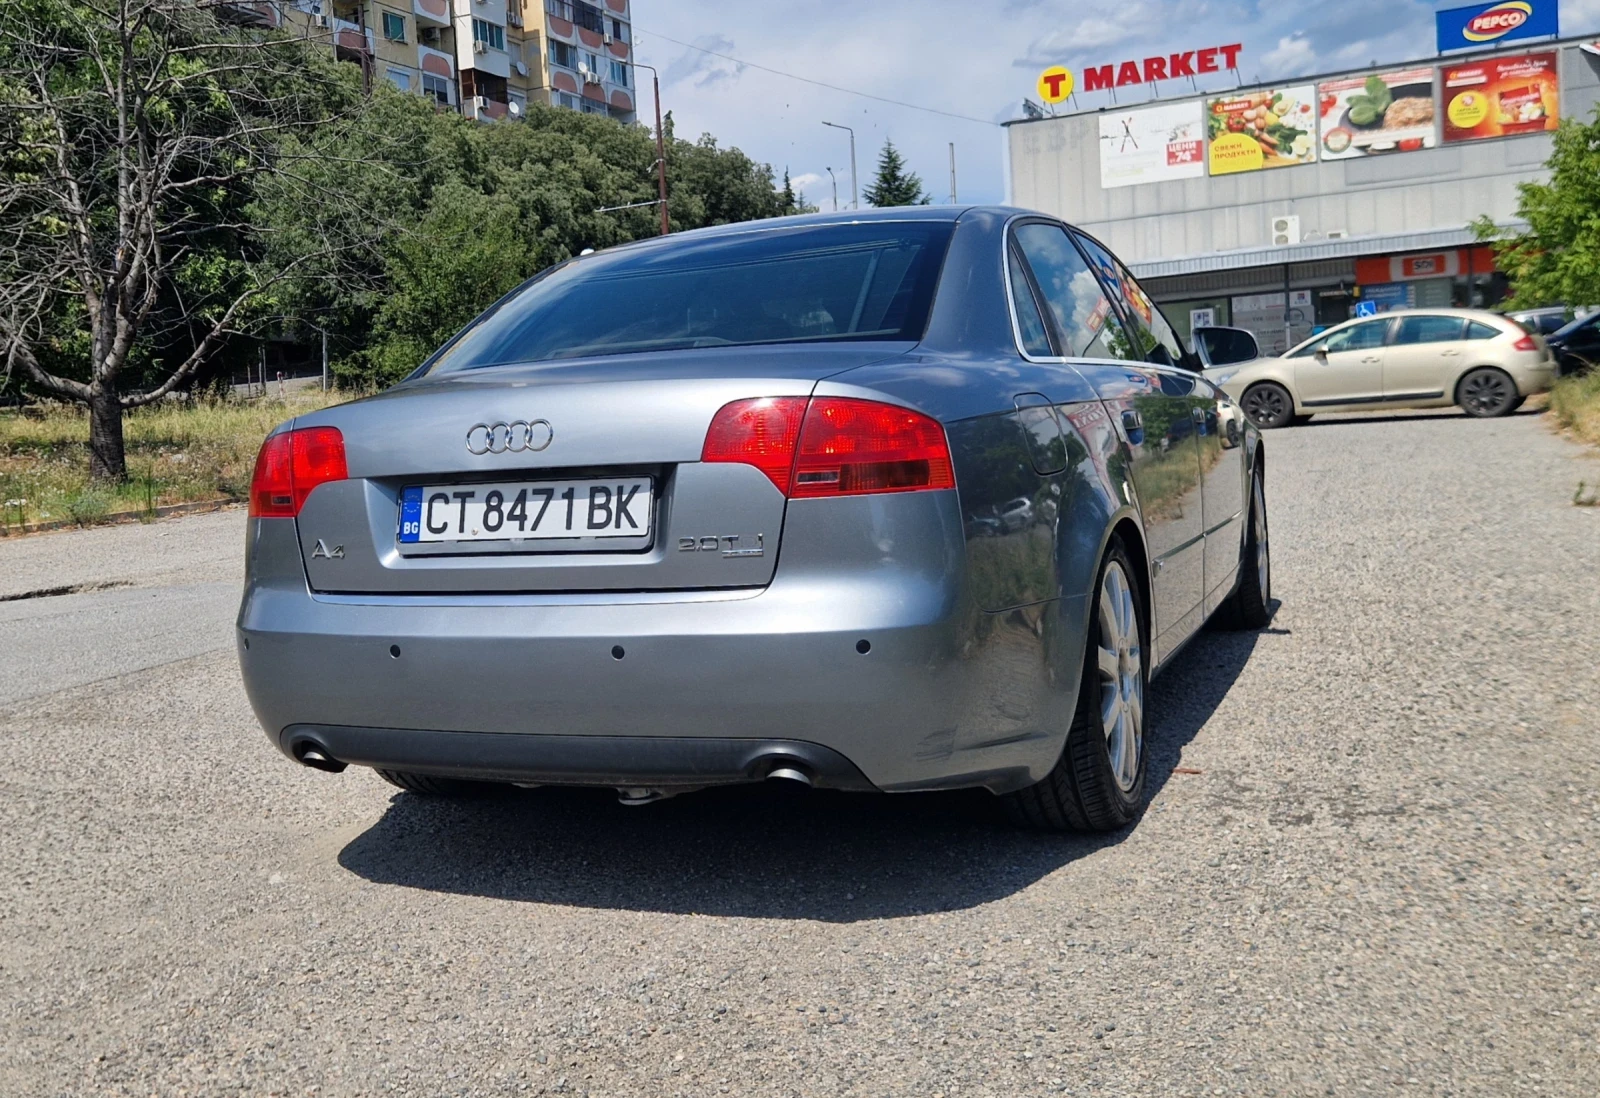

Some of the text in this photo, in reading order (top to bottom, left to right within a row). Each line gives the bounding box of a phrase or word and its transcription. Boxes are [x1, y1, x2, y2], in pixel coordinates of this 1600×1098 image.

[1473, 12, 1522, 31] PEPCO
[1044, 44, 1242, 98] T MARKET
[1168, 141, 1196, 152] ЦЕНИ
[1214, 143, 1242, 152] СВЕЖИ
[1214, 149, 1256, 160] ПРОДУКТИ
[426, 484, 641, 534] CT 8471 BK
[403, 521, 419, 535] BG
[311, 539, 345, 560] A4
